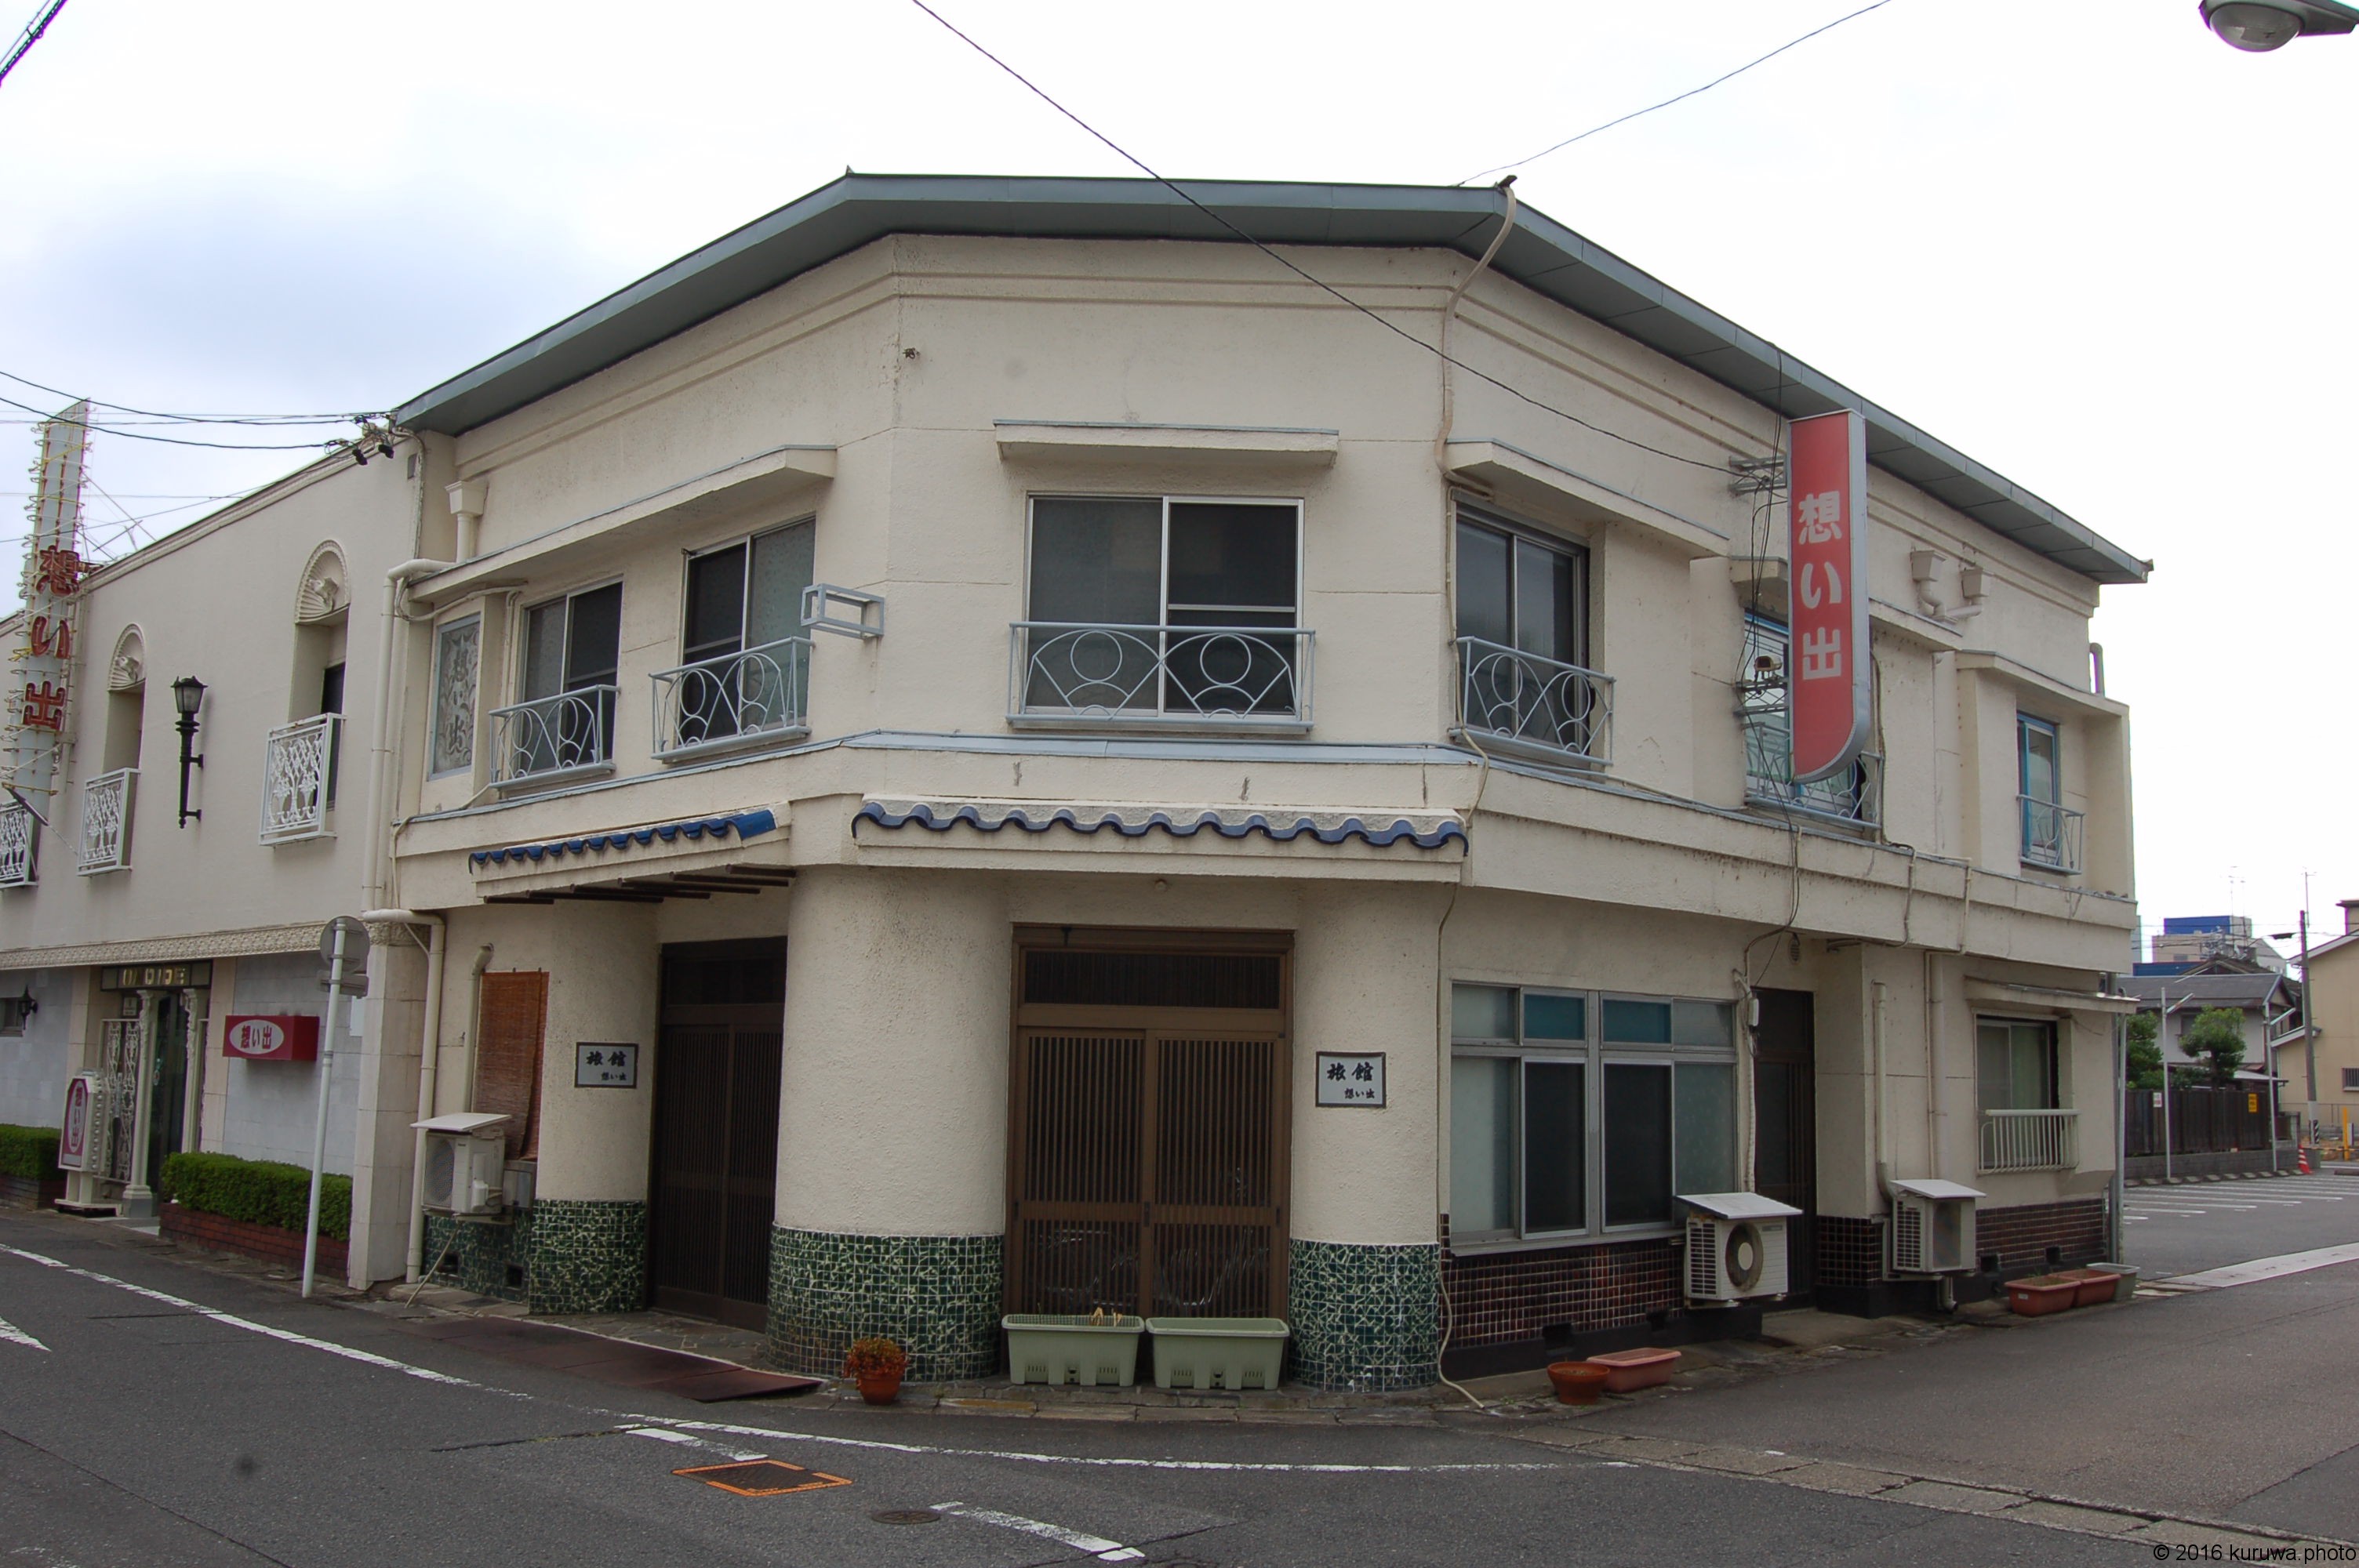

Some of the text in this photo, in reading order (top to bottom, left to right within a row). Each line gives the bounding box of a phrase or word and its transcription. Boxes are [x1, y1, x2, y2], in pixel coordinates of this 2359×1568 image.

[1798, 491, 1842, 680] 想い出
[22, 545, 79, 729] 想い出
[241, 1025, 272, 1049] 想い出
[587, 1051, 626, 1066] 旅館
[1327, 1062, 1373, 1081] 旅館
[1345, 1088, 1375, 1098] 想い出
